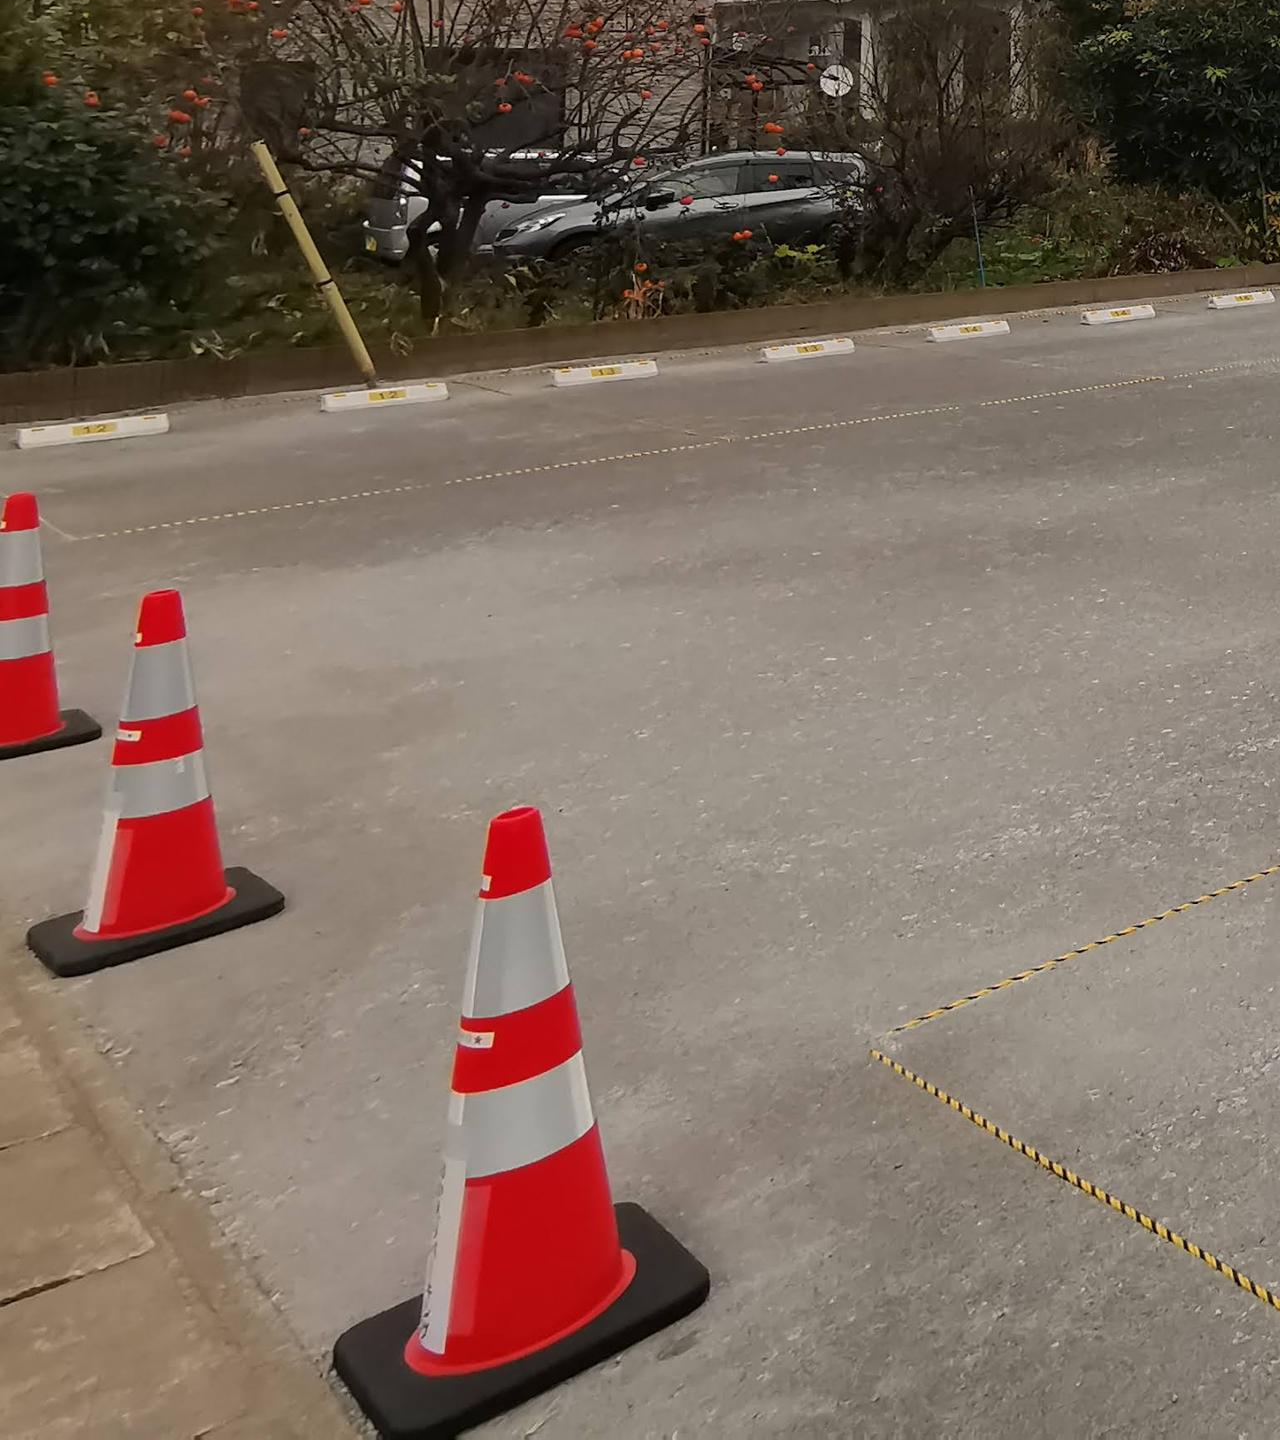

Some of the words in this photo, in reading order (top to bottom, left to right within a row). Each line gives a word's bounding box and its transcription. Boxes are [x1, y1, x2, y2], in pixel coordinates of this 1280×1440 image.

[803, 345, 818, 353] 13
[600, 367, 616, 376] 13
[379, 390, 398, 400] 12
[83, 425, 107, 435] 12
